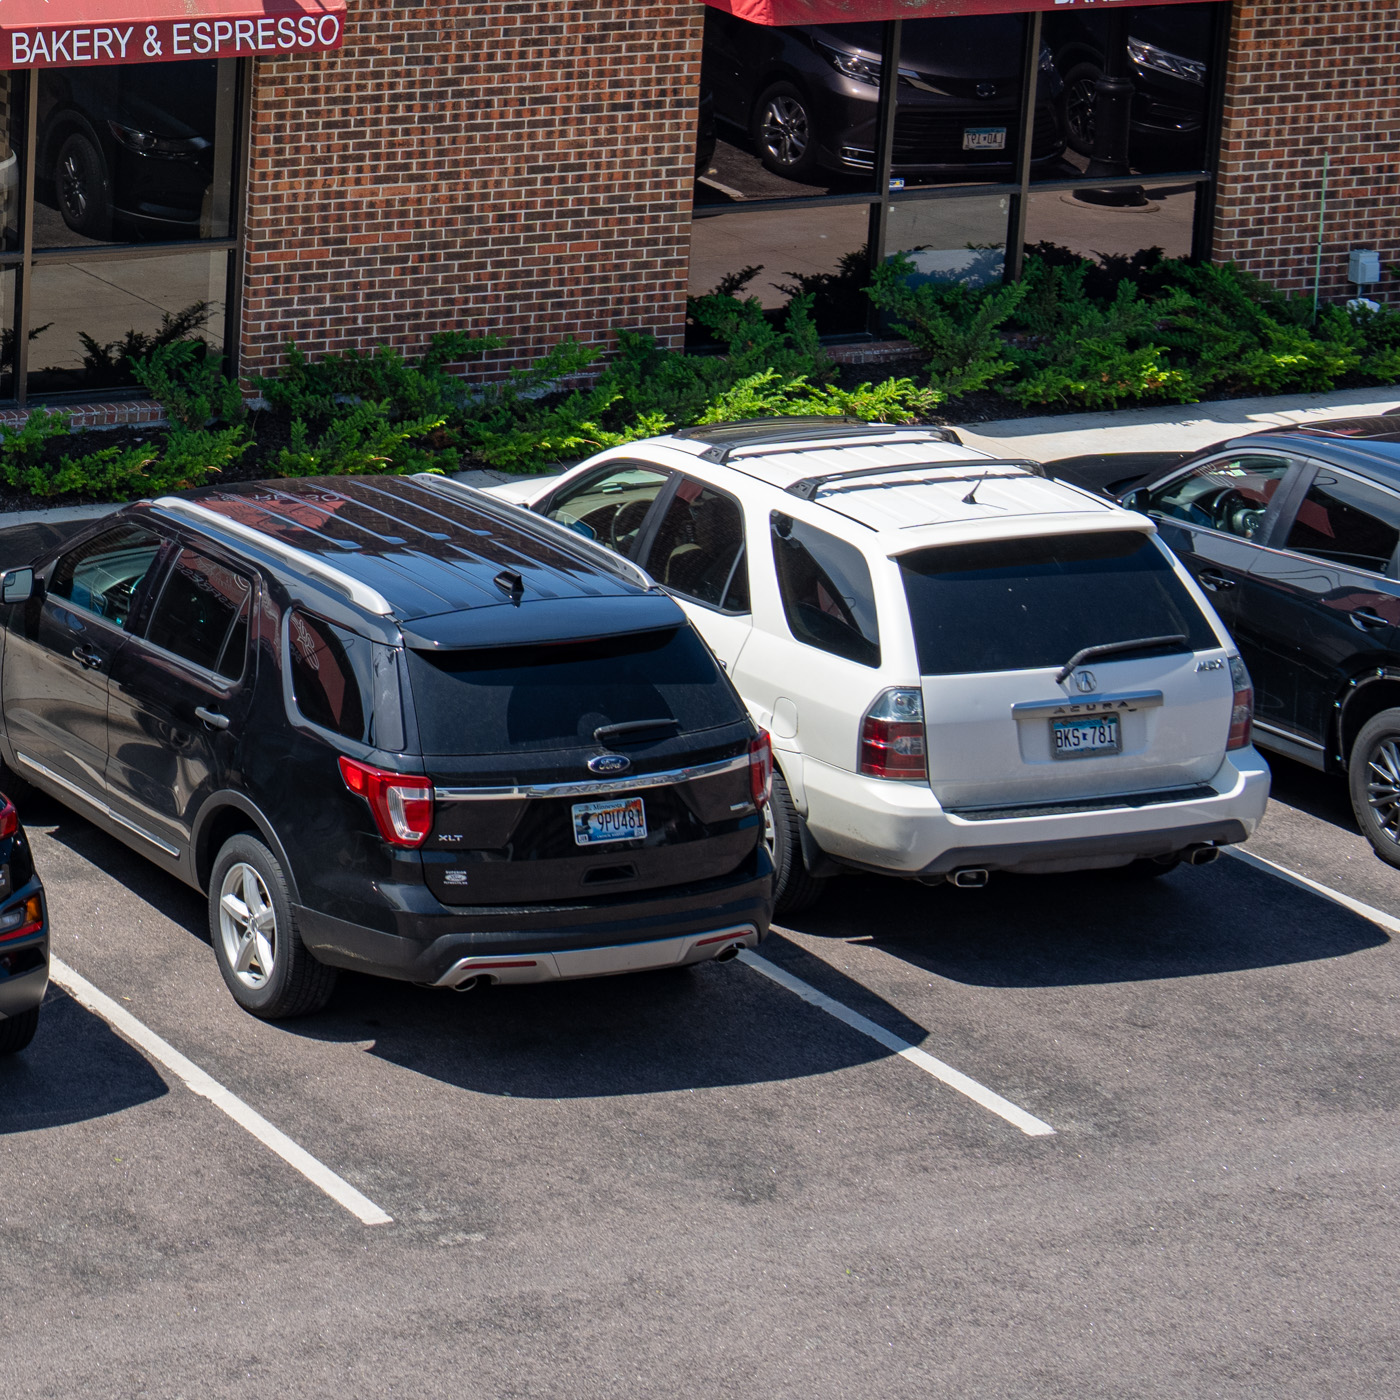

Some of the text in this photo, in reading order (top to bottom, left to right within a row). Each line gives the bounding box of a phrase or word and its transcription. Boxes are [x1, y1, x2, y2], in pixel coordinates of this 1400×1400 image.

[11, 13, 340, 64] BAKERY & ESPRESSO
[1053, 701, 1129, 714] ACURA
[1055, 725, 1115, 748] BKS 781
[599, 758, 621, 770] Ford
[597, 808, 643, 832] 9PU481
